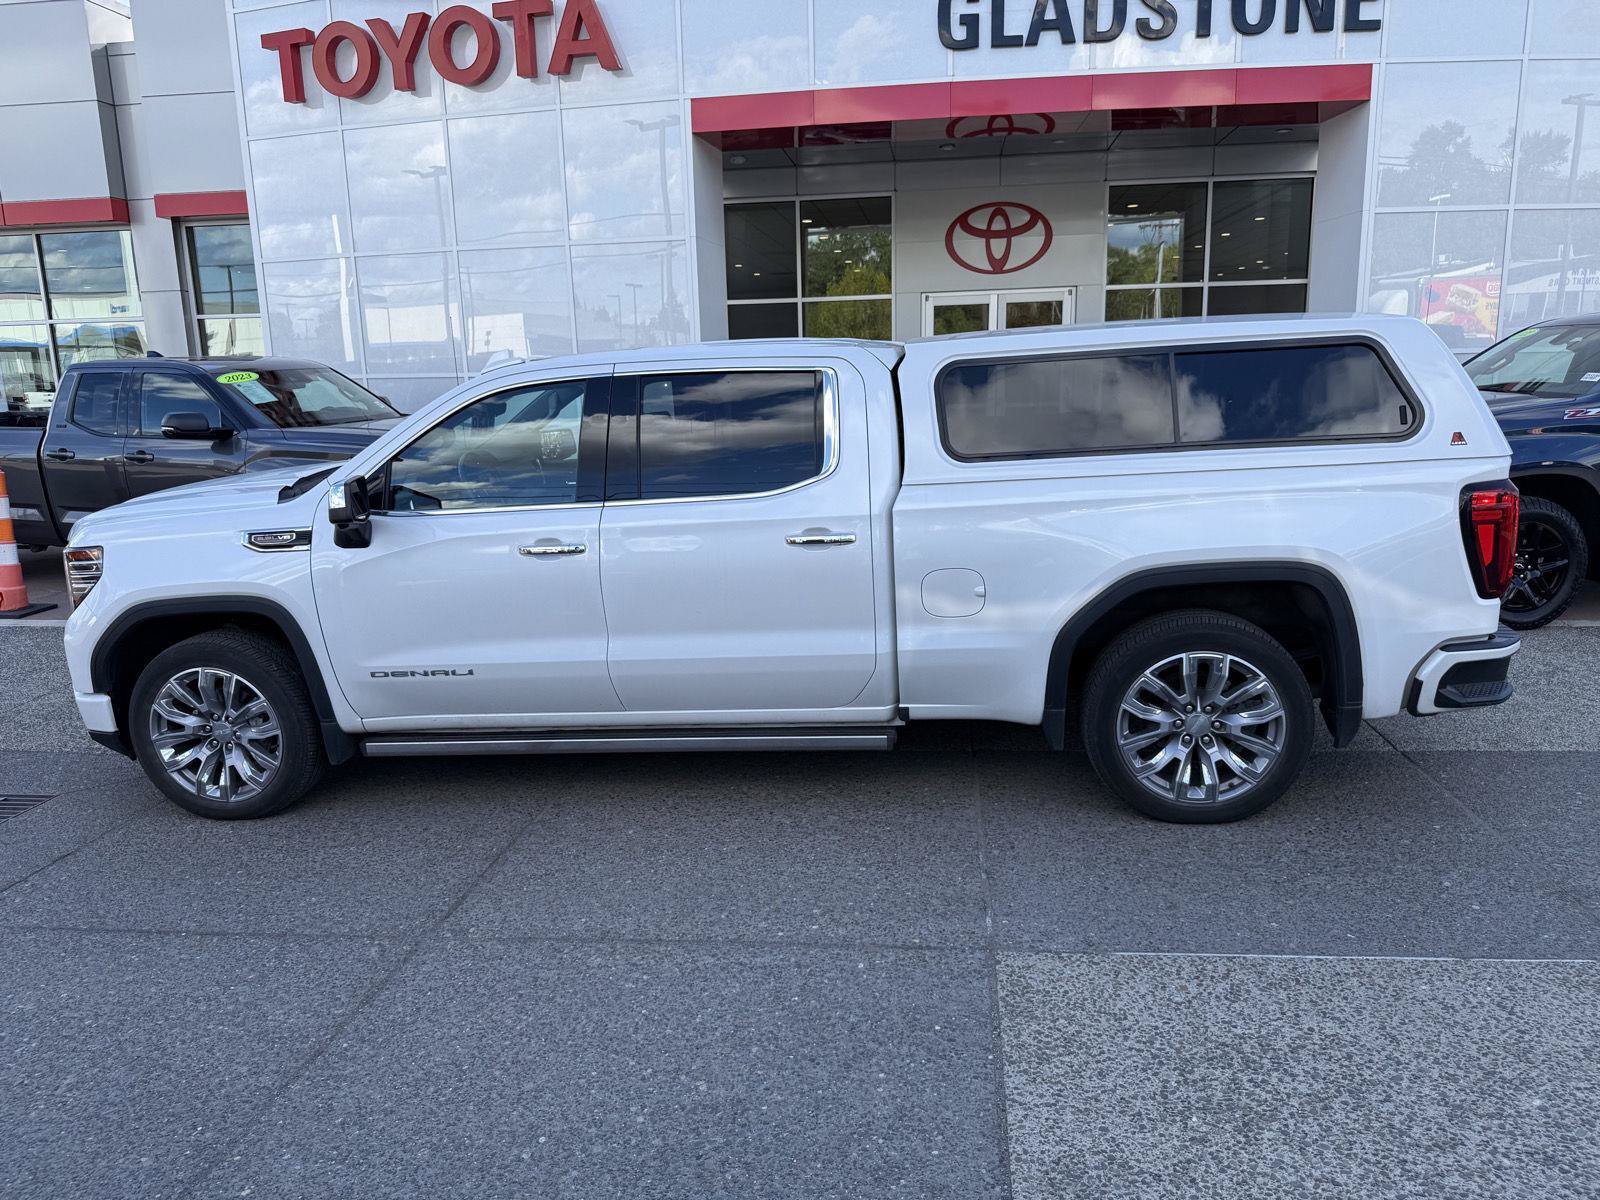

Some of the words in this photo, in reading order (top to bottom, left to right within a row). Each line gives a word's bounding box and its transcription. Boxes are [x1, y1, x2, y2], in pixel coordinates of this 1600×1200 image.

[260, 0, 623, 104] TOYOTA
[224, 373, 252, 383] 2023
[369, 668, 474, 678] DENALI
